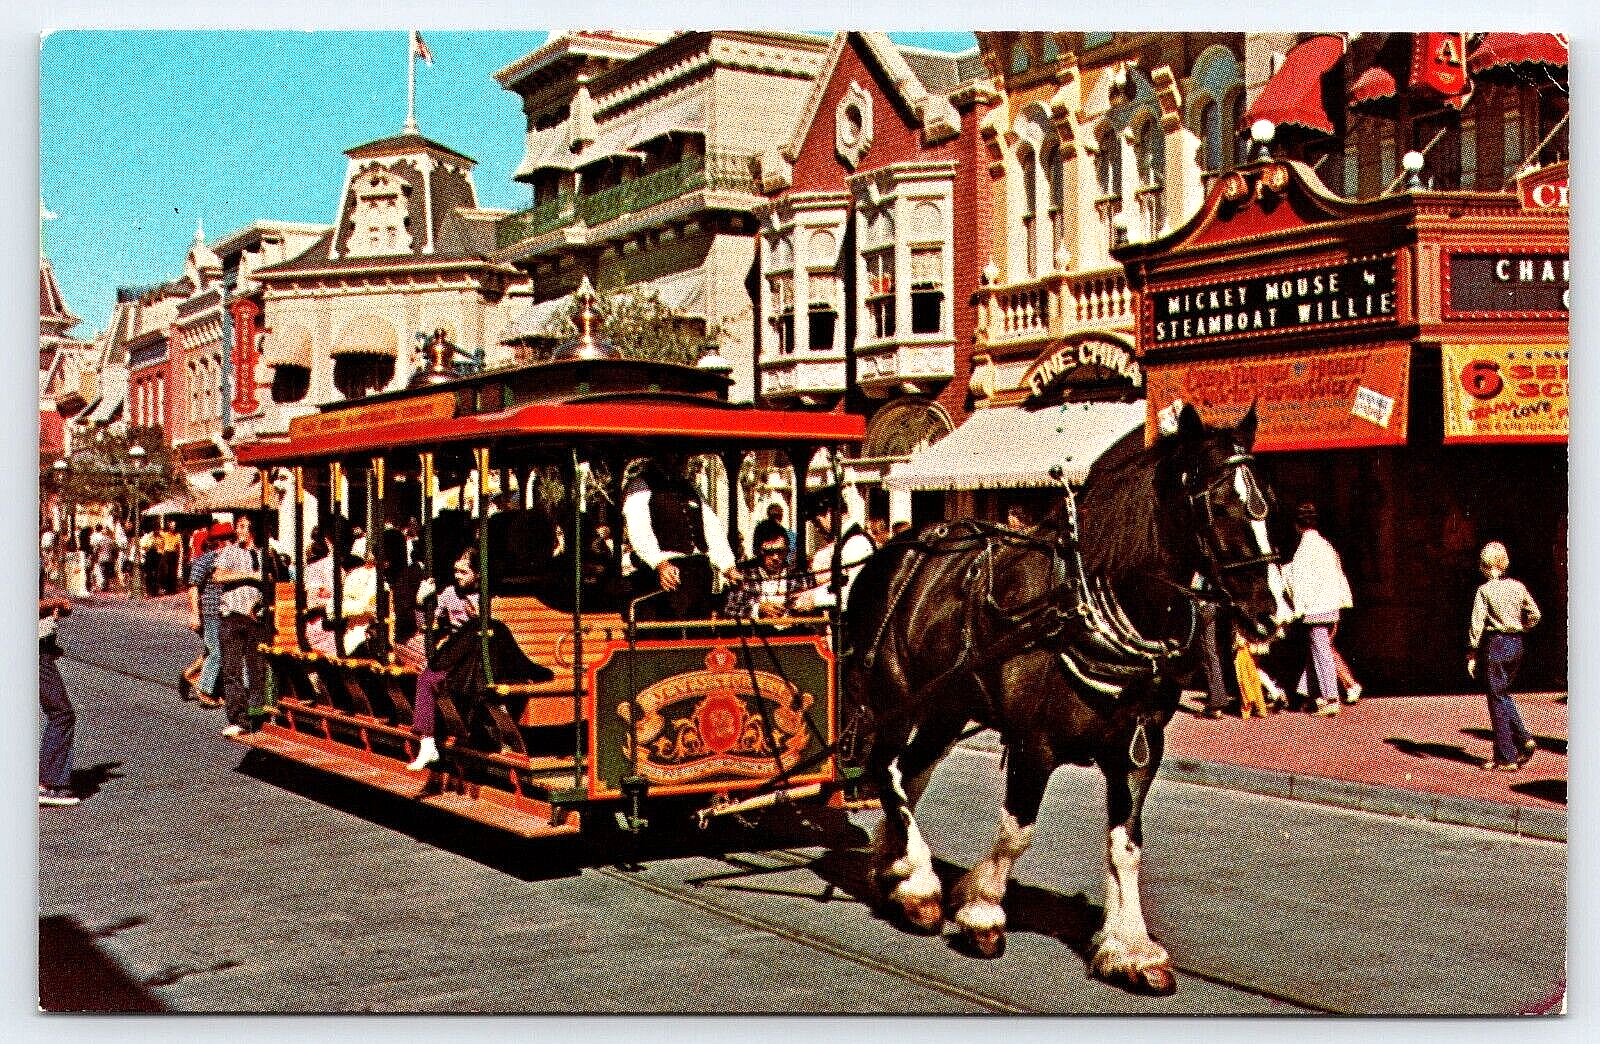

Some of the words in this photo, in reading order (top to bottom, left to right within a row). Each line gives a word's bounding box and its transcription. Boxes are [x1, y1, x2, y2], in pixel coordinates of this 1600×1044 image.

[1168, 286, 1248, 315] MICKEY
[1265, 273, 1340, 302] MOUSE
[1156, 306, 1278, 340] STEAMBOAT
[1298, 292, 1391, 323] WILLIE
[1028, 346, 1077, 397] FINE
[1078, 340, 1143, 388] CHINA
[1460, 359, 1504, 400] 6
[1512, 400, 1553, 420] LOVE
[1515, 383, 1569, 398] SC
